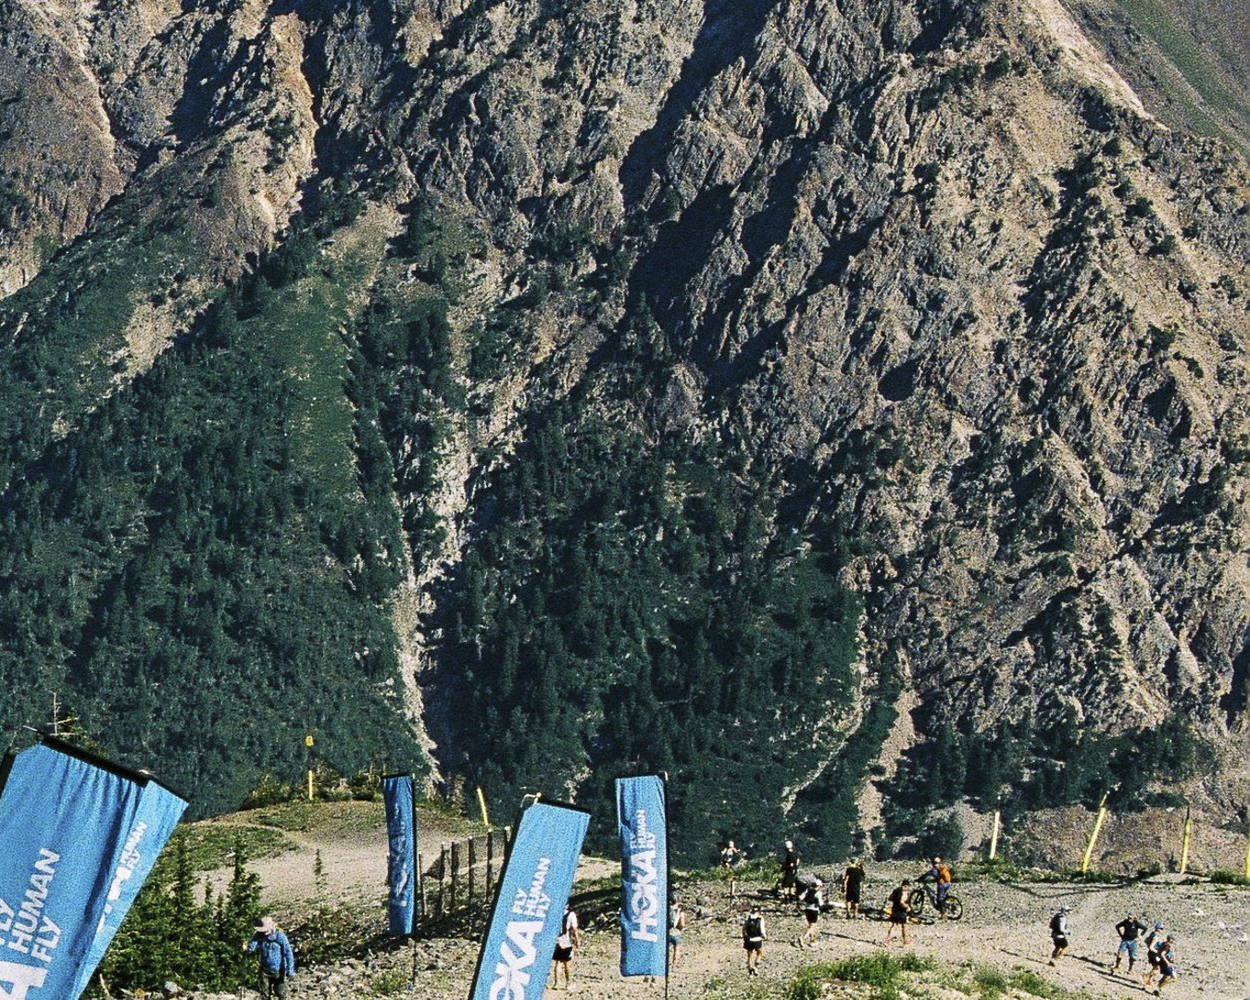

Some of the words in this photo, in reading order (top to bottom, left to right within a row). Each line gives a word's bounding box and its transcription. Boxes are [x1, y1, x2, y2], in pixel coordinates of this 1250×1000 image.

[7, 847, 60, 954] HUMAN
[523, 857, 551, 917] HUMAN
[631, 850, 658, 942] HOKA
[30, 915, 61, 963] FLY
